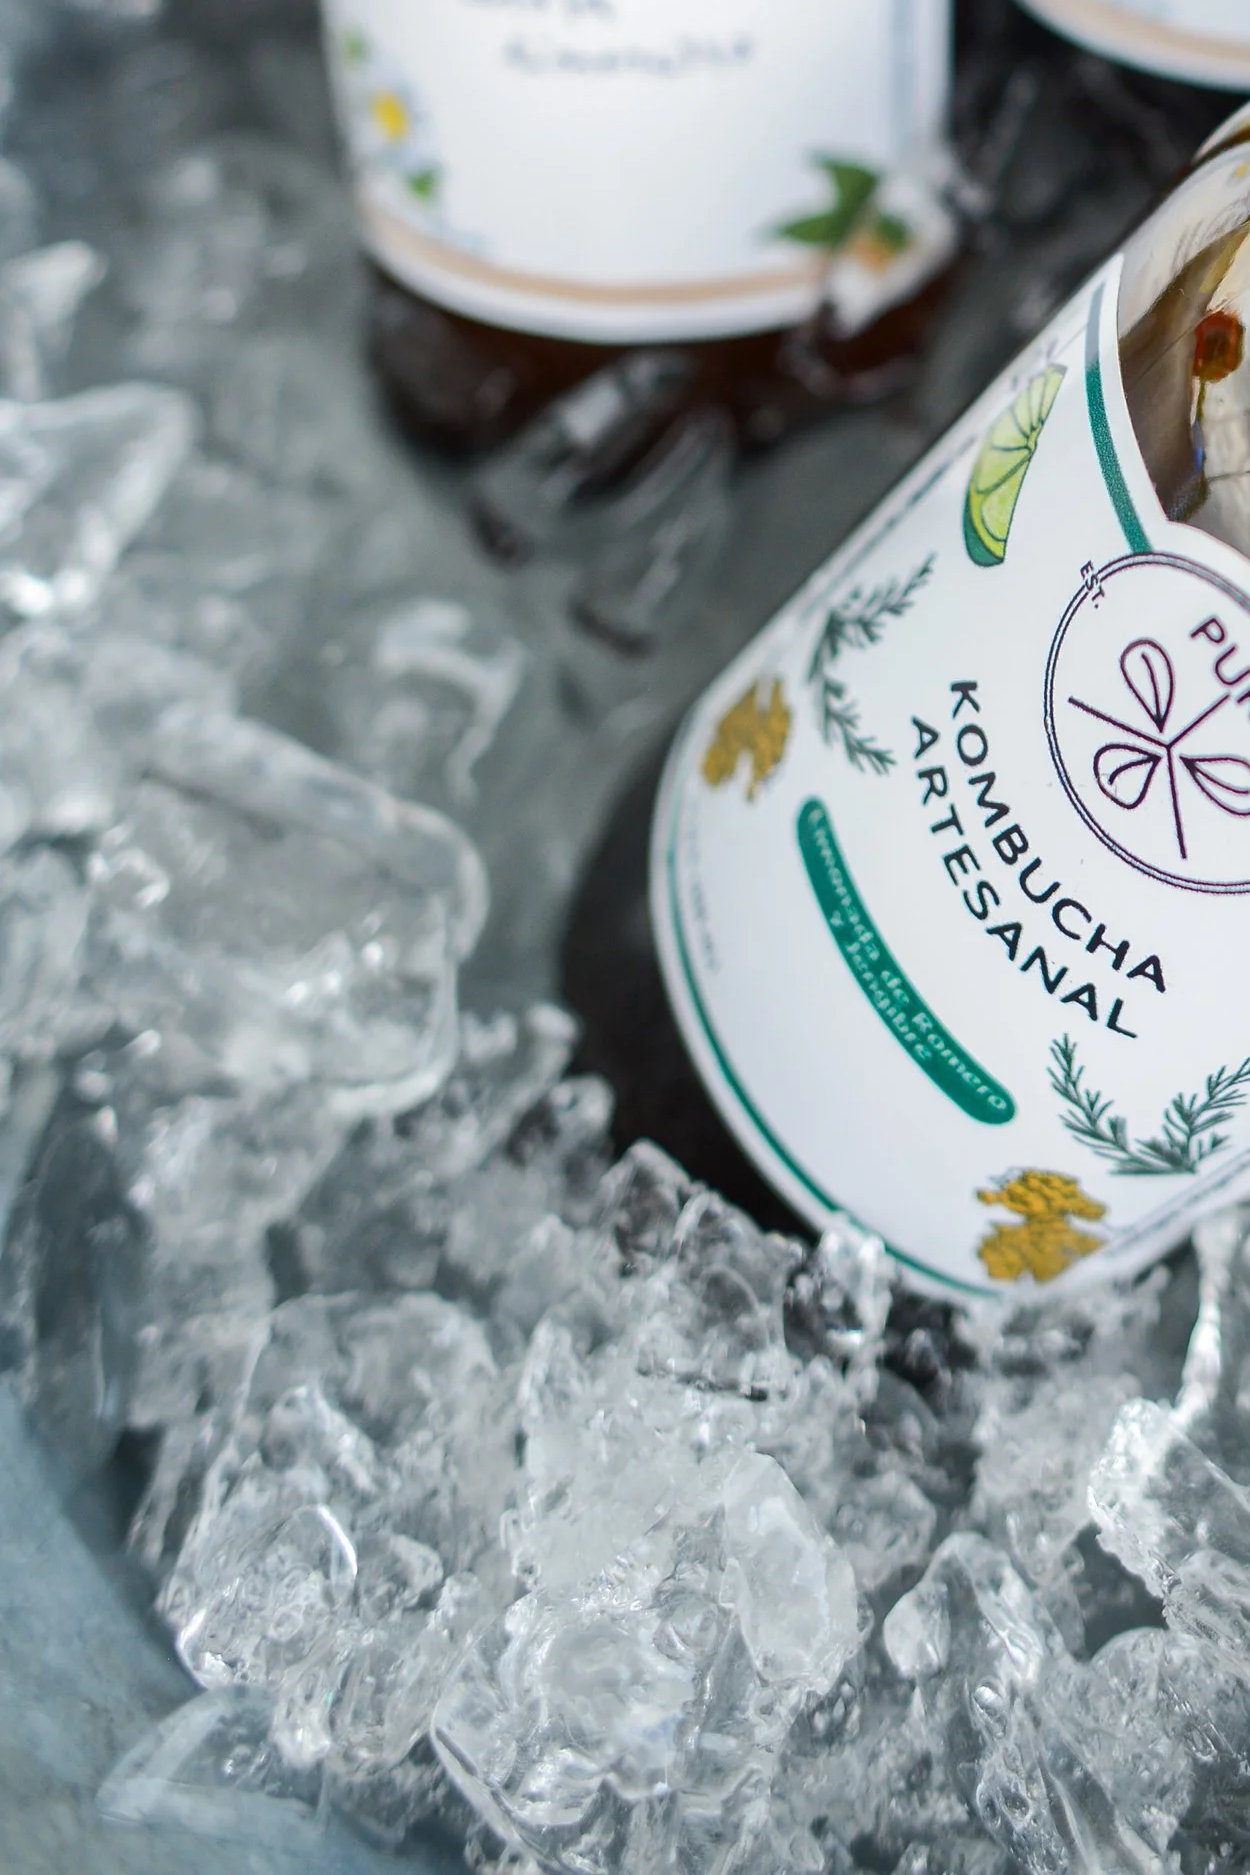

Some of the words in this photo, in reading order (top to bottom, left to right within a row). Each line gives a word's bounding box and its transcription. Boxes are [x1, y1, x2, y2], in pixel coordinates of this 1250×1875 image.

[1079, 560, 1106, 609] EST.
[910, 714, 1139, 1040] ARTESANAL
[950, 680, 1167, 994] KOMBUCHA
[846, 939, 932, 1060] Jengibre
[881, 970, 909, 1006] de
[911, 1010, 1008, 1110] Romero
